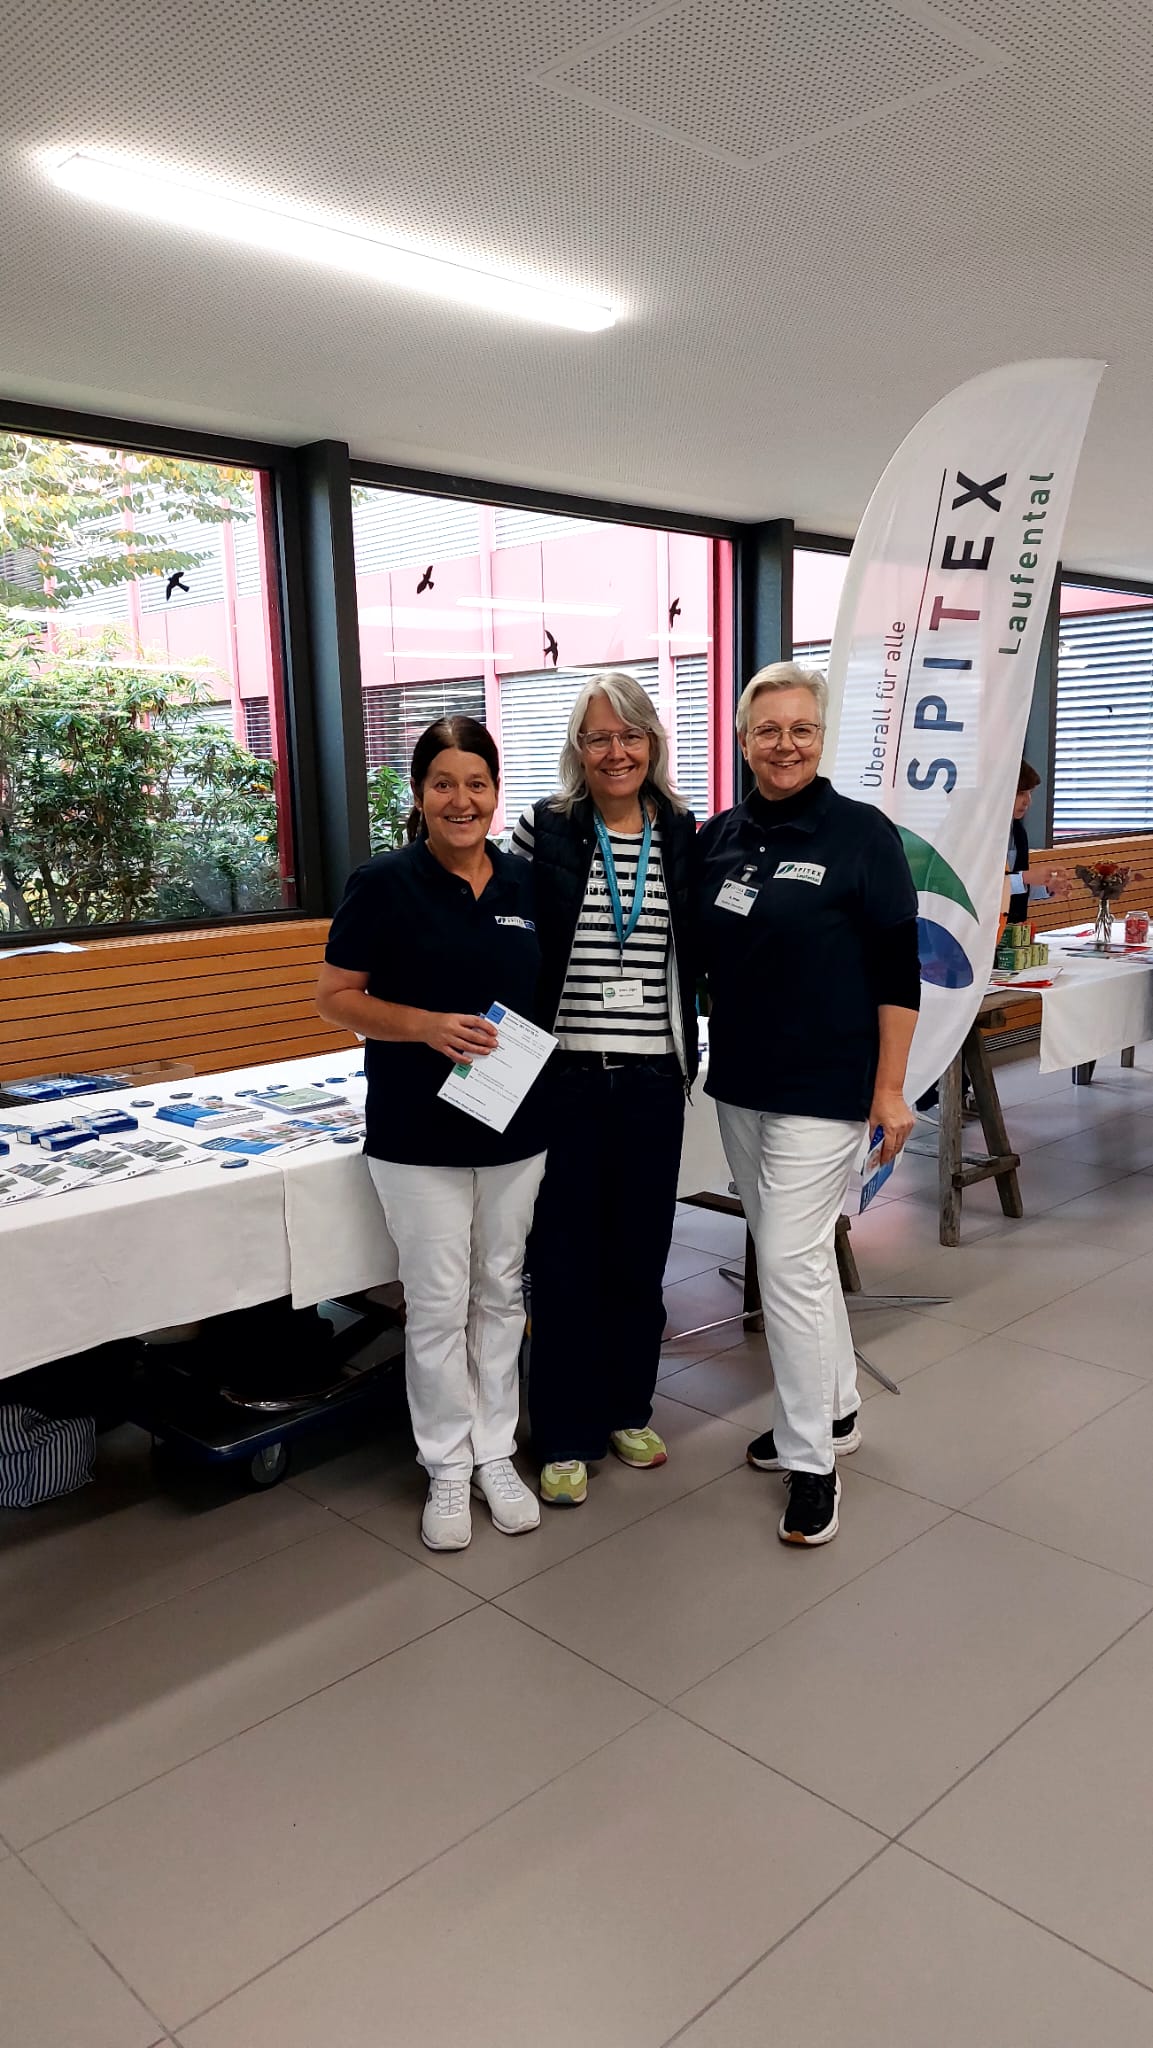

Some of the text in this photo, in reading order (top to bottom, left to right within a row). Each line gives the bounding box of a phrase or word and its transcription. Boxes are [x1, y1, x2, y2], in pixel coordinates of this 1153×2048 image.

[906, 470, 1008, 794] SPITEX
[998, 471, 1055, 655] Laufental
[859, 620, 906, 788] Überall für alle
